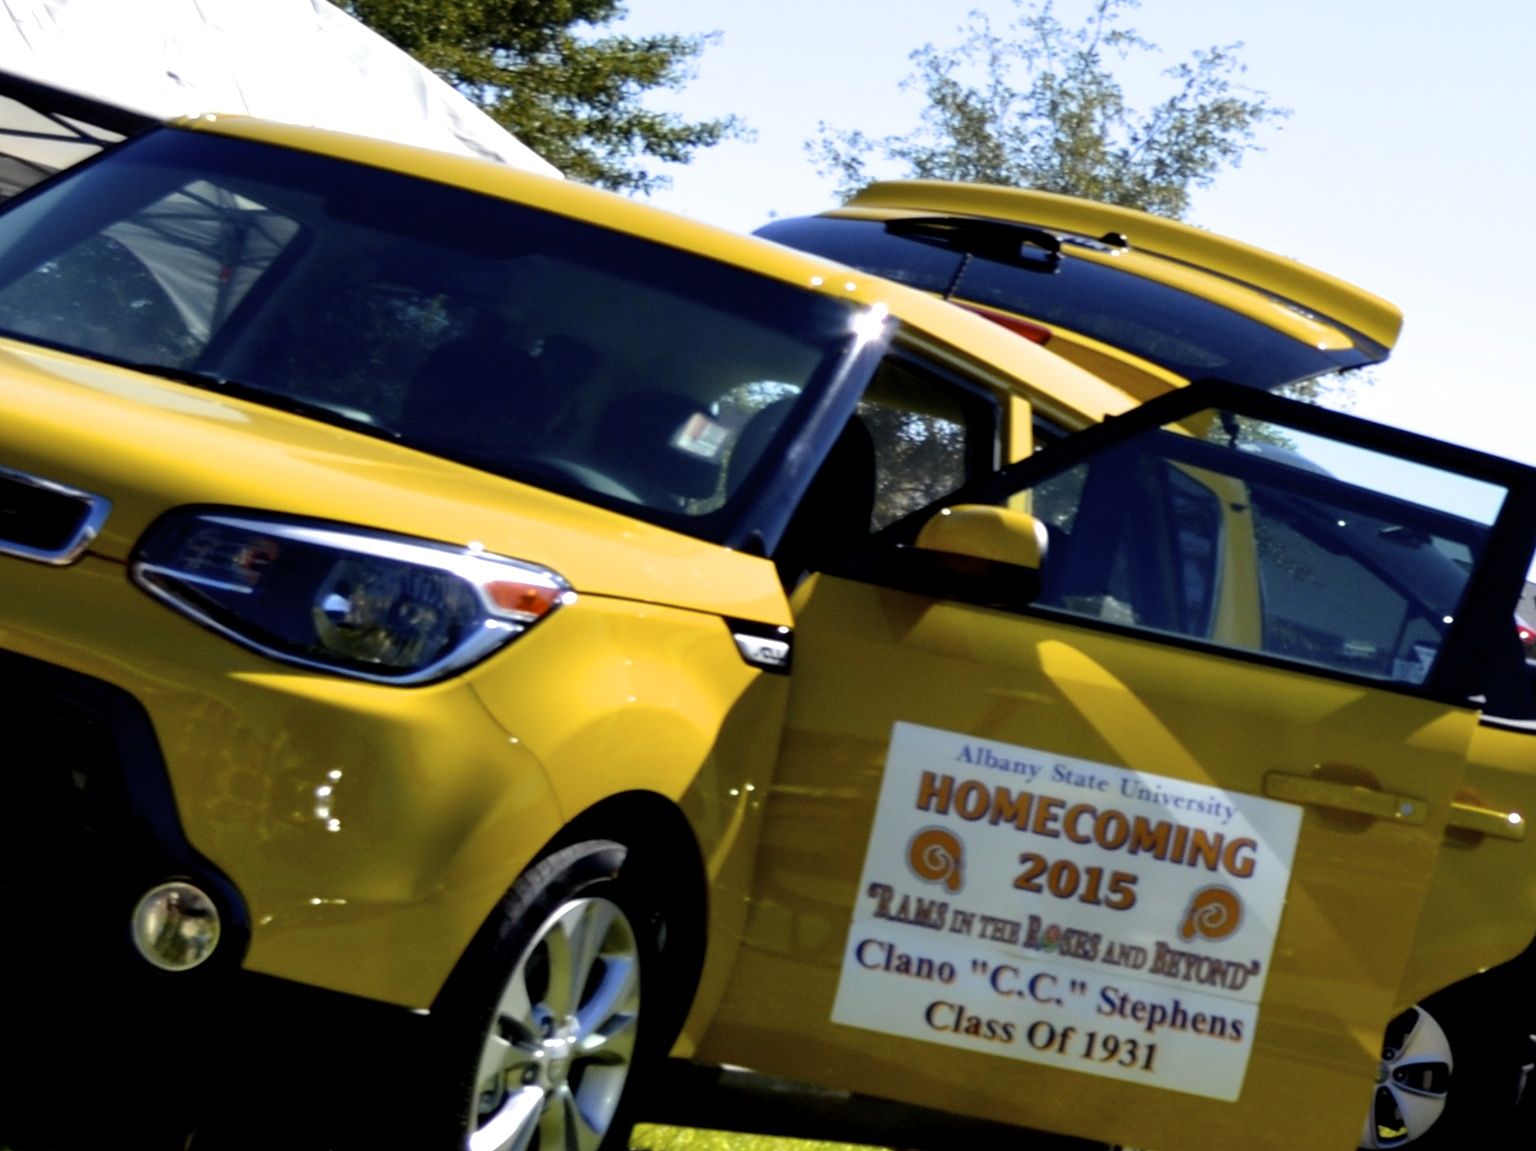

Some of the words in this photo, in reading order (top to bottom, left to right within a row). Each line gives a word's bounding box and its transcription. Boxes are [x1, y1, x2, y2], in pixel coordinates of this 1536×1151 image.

[956, 745, 1043, 783] Albany
[1051, 764, 1110, 793] State
[1120, 777, 1238, 825] University
[915, 770, 1259, 879] HOMECOMING
[1012, 852, 1139, 911] 2015
[949, 909, 976, 936] IN
[978, 914, 1022, 946] THE
[1024, 914, 1102, 961] ROSES
[1101, 941, 1148, 970] AND
[855, 938, 956, 984] Clano
[1097, 986, 1244, 1042] Stephens
[924, 1000, 1016, 1043] Class
[1026, 1020, 1077, 1055] Of
[1081, 1031, 1159, 1074] 1931
